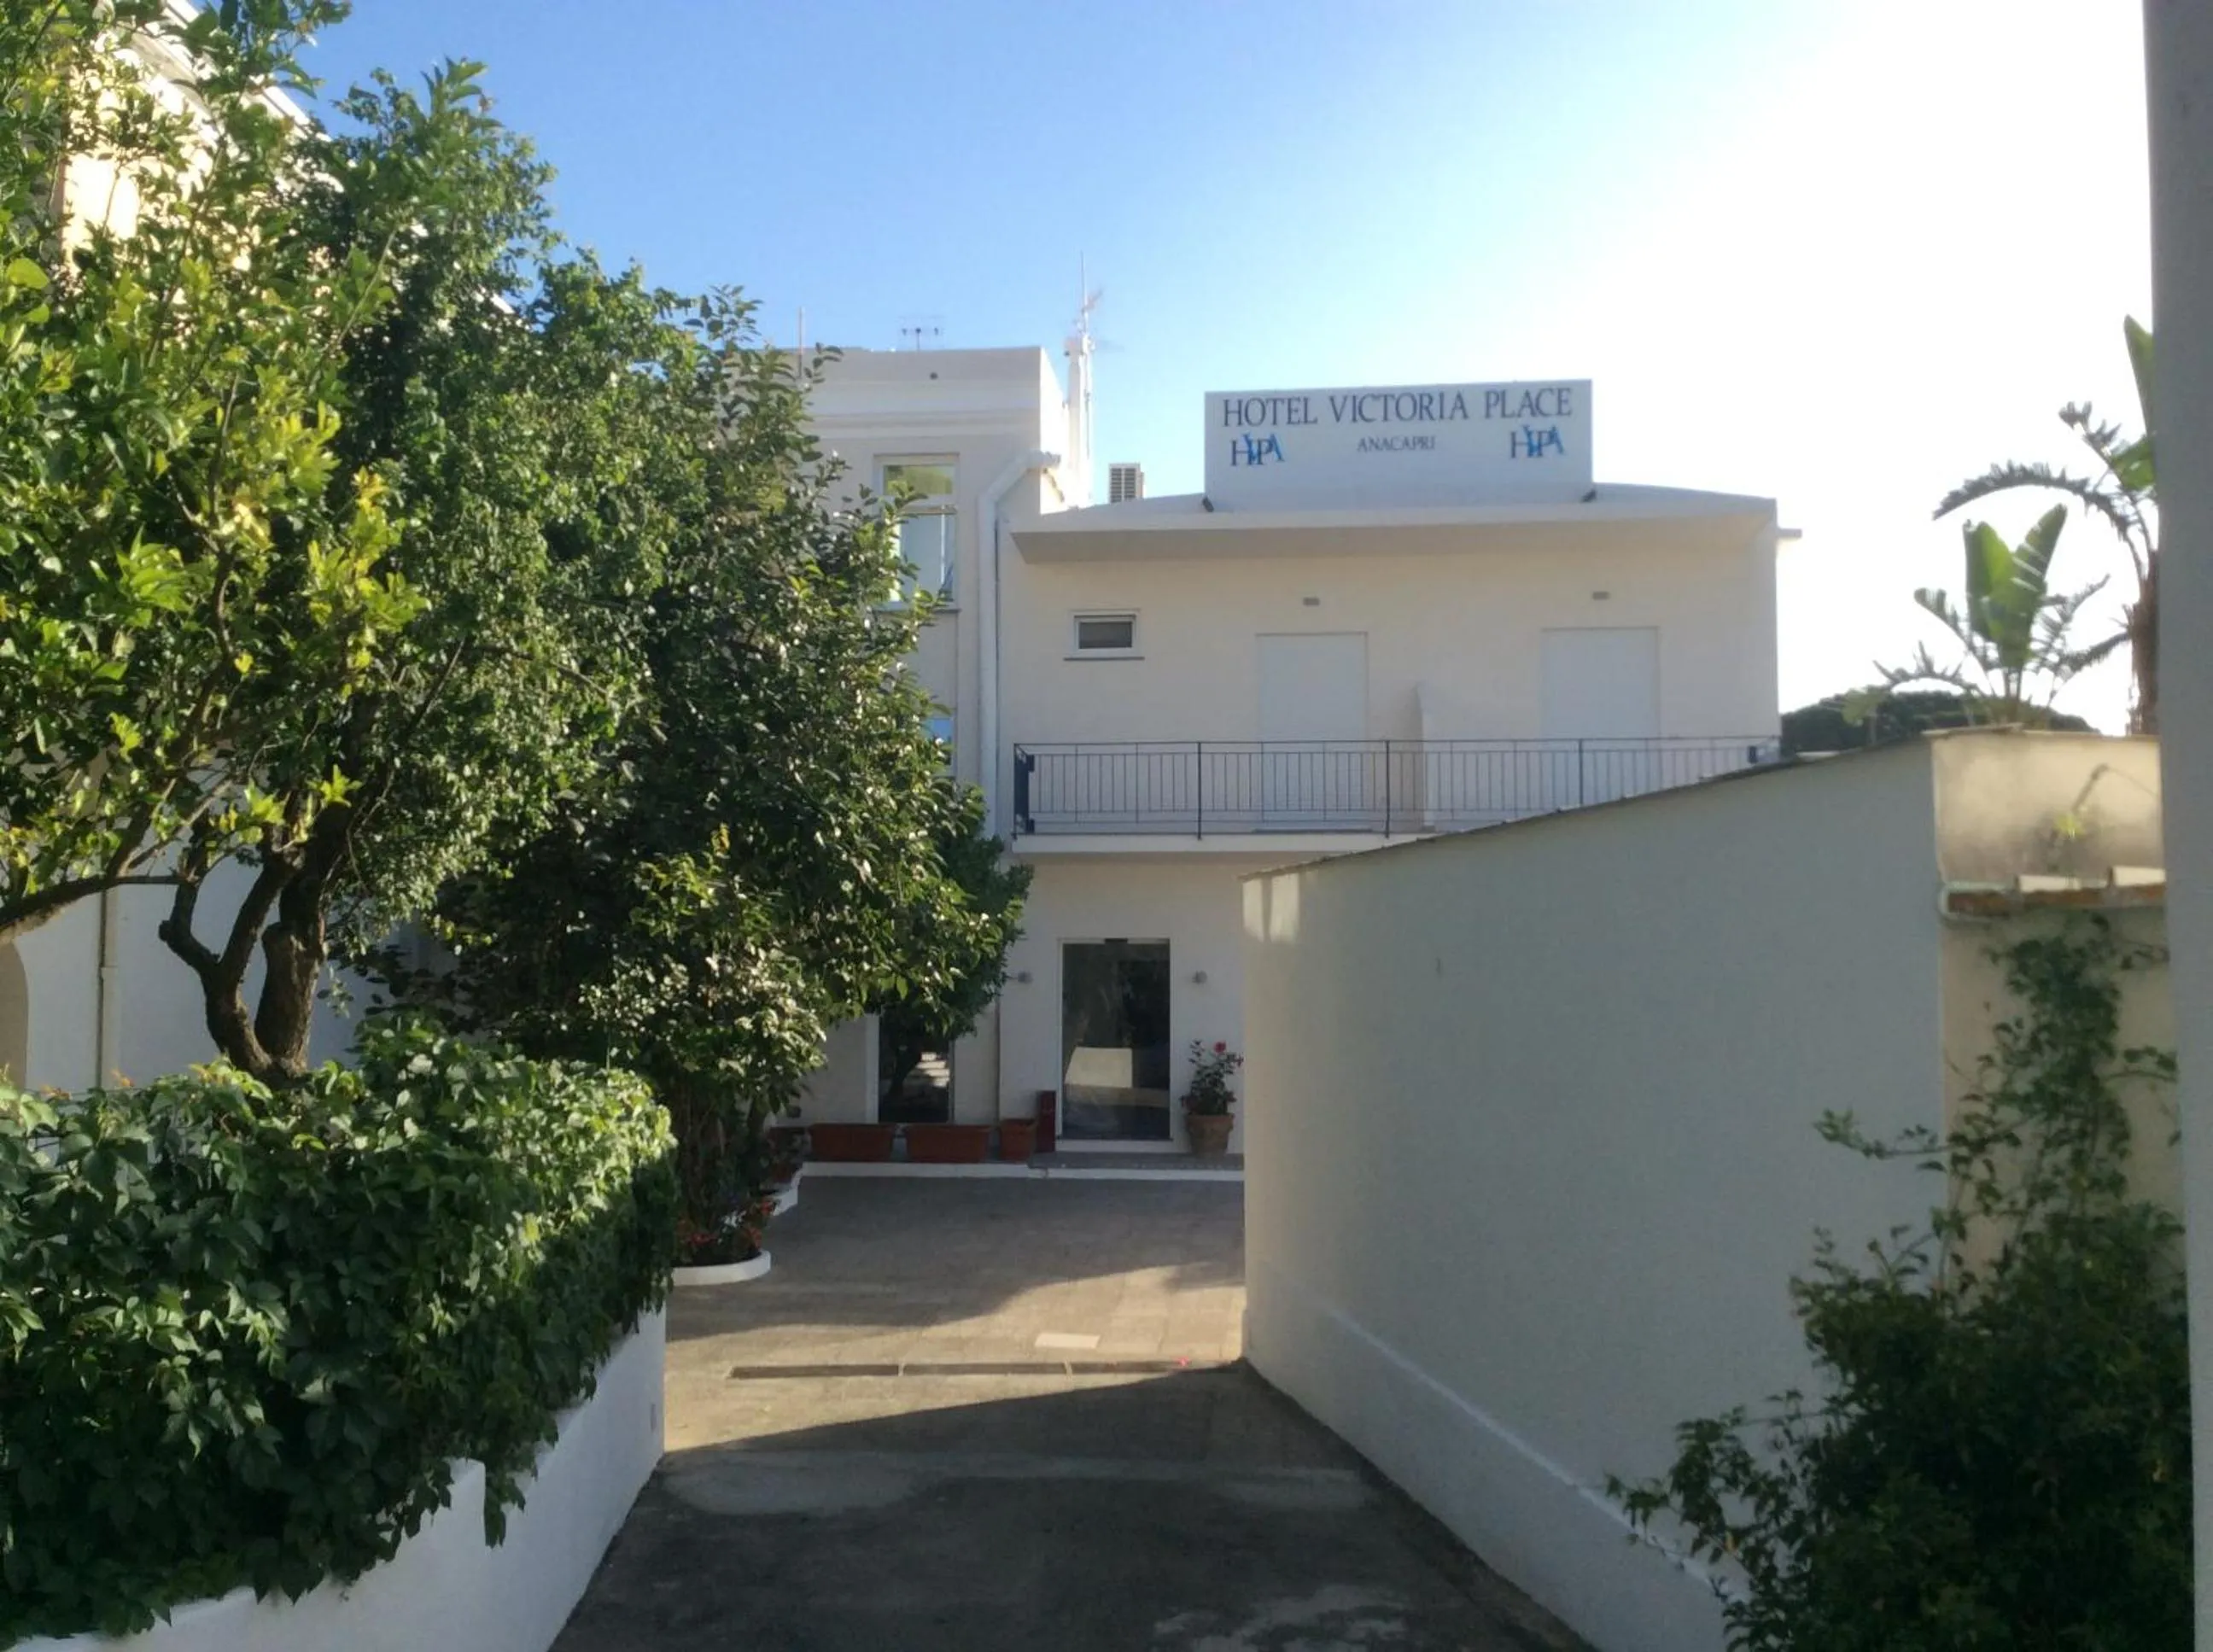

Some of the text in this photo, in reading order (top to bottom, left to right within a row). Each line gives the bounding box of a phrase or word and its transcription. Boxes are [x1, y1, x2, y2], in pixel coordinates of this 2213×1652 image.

[1223, 388, 1572, 427] HOTEL VICTORIA PLACE
[1356, 435, 1436, 452] ANACAPRI
